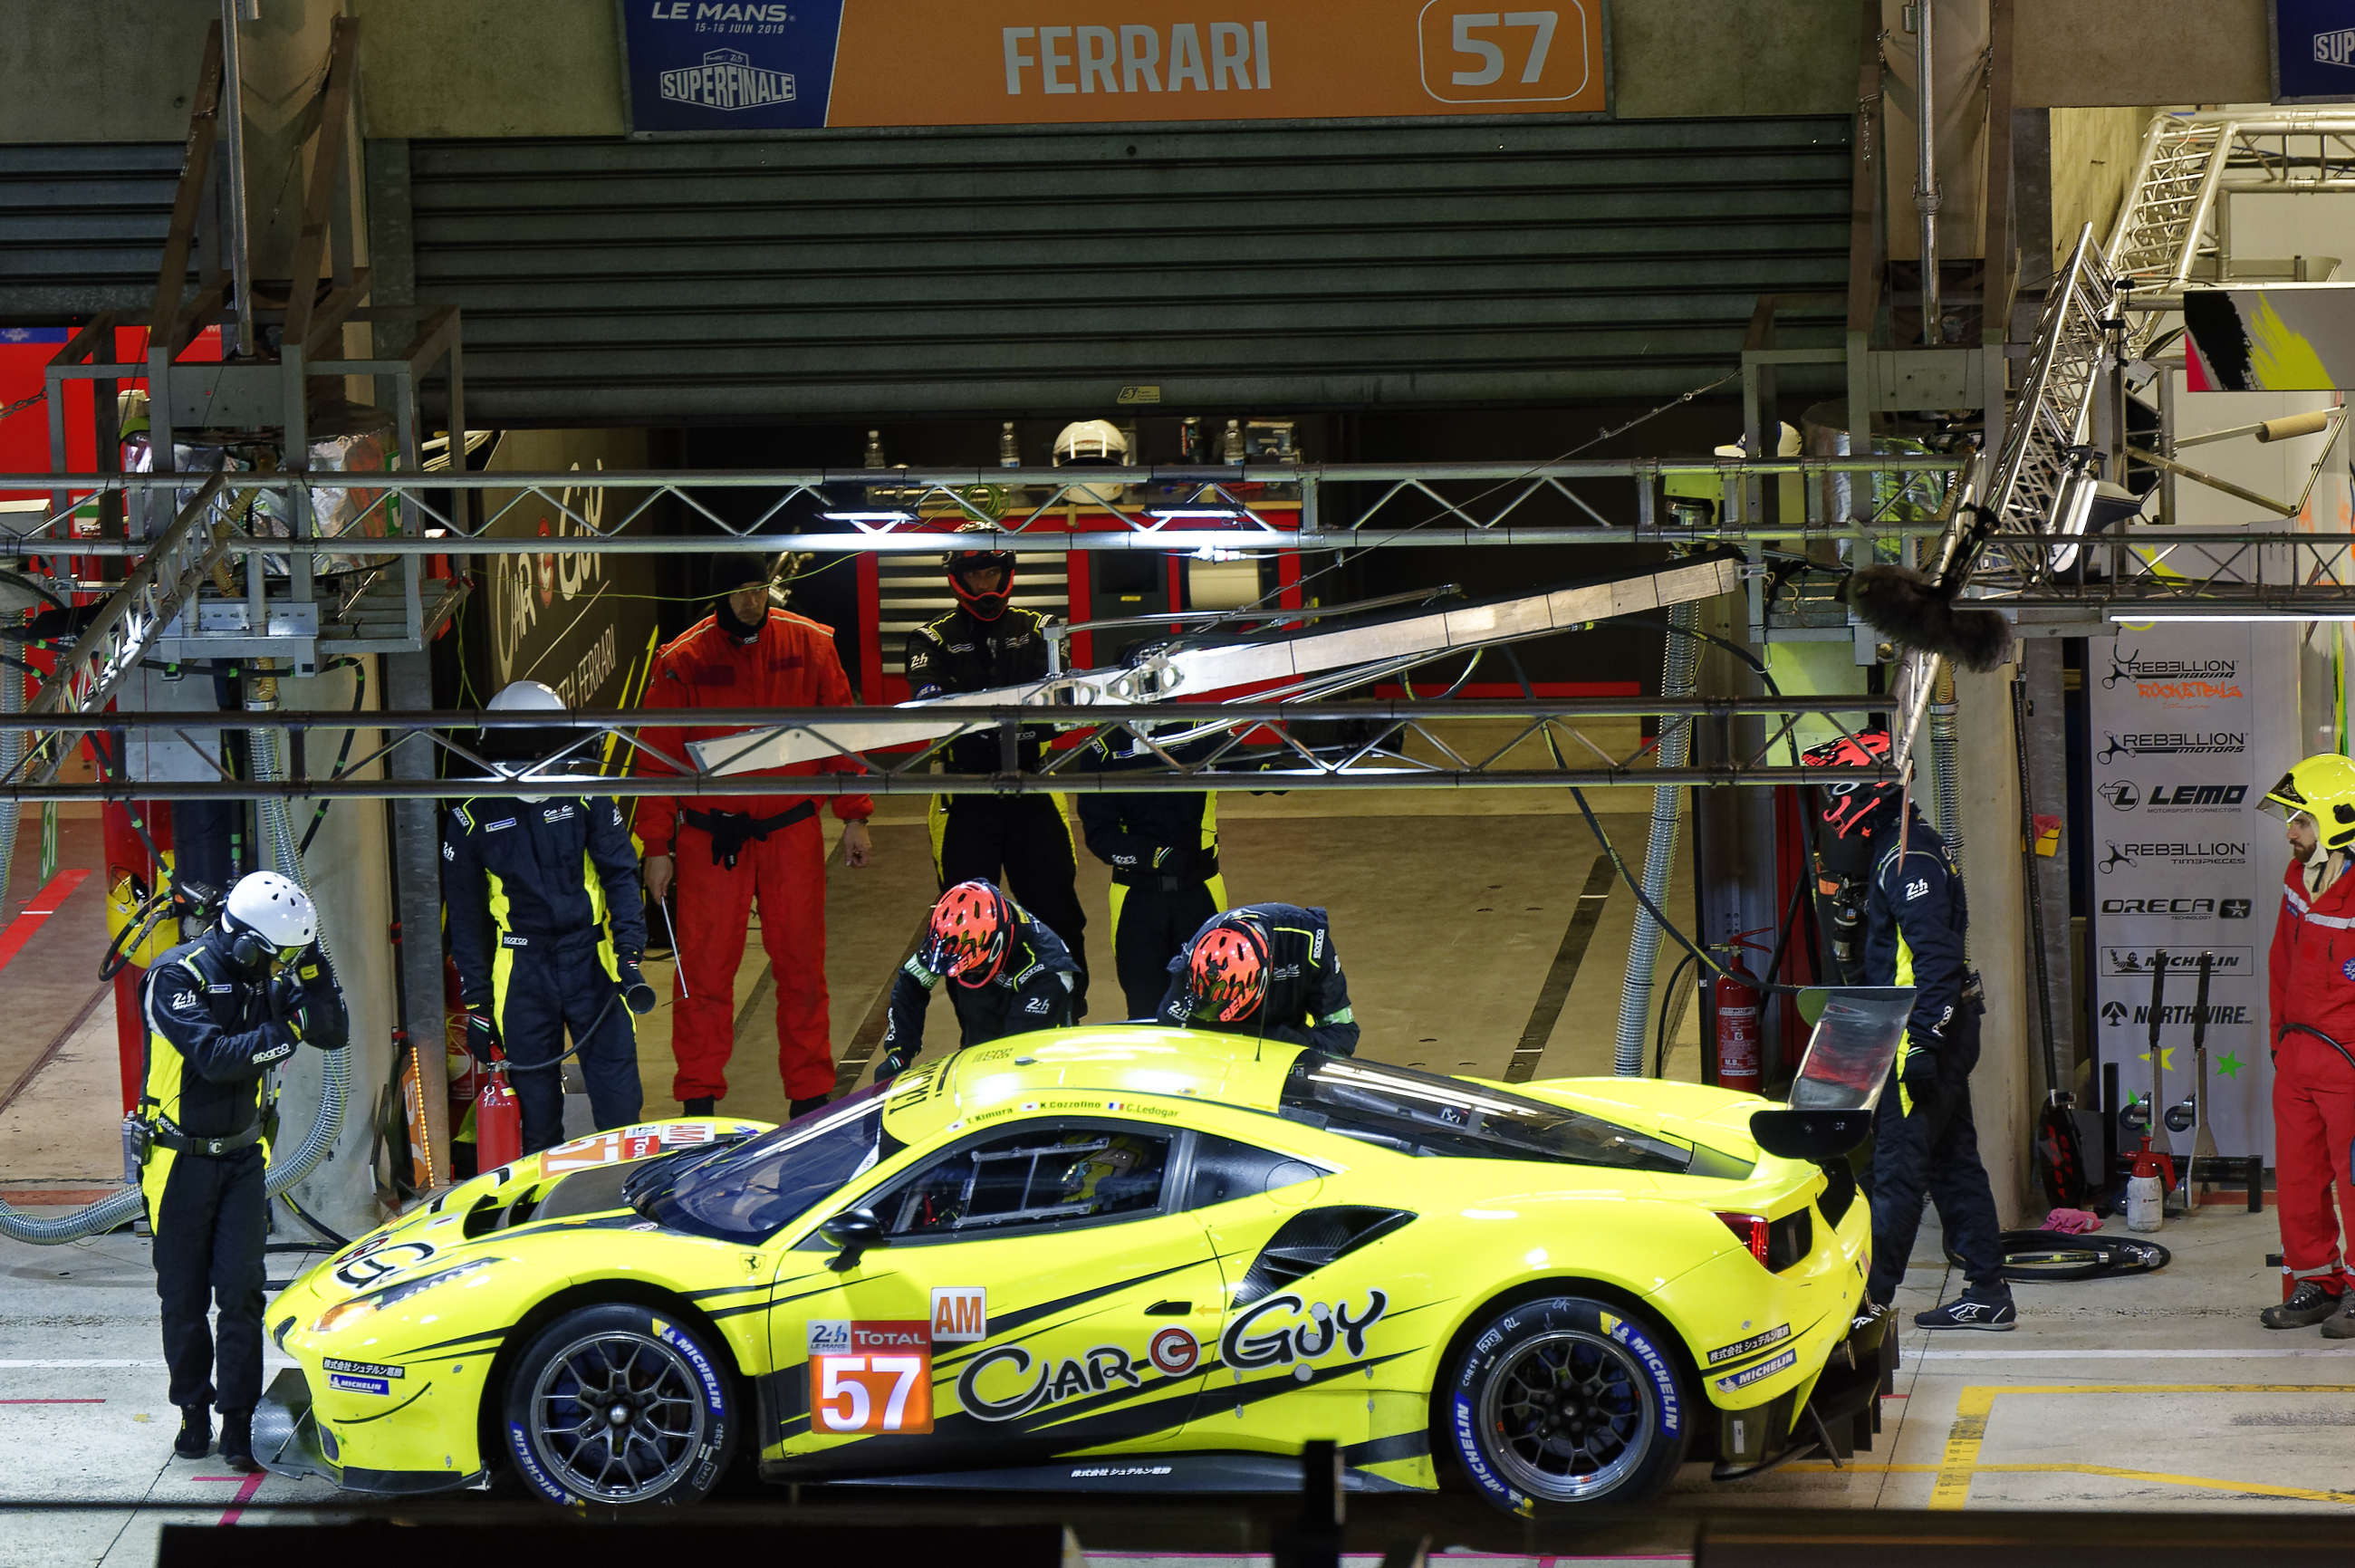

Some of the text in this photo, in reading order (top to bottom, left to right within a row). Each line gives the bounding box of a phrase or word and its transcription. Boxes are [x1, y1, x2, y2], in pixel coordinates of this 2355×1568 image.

[651, 2, 787, 22] LE MANS
[695, 23, 784, 34] 15-16 JUIN 2019
[1003, 21, 1271, 95] FERRARI
[1451, 11, 1559, 86] 57
[664, 65, 793, 107] SUPERFINALE
[578, 623, 615, 709] FERRARI
[2123, 733, 2244, 746] REBELLION
[2148, 785, 2249, 804] LEMO
[2125, 843, 2245, 855] REBELLION
[2101, 899, 2216, 913] ORECA
[547, 1132, 620, 1172] 57
[812, 1324, 848, 1343] 24h
[934, 1296, 982, 1334] AM
[1710, 1344, 1744, 1362] 株式会社
[1739, 1352, 1793, 1384] MICHELIN
[341, 1380, 381, 1390] MICHELIN
[677, 1337, 722, 1409] MICHELIN
[1631, 1336, 1677, 1429] MICHELIN
[821, 1356, 921, 1431] 57
[514, 1429, 562, 1499] MICHELIN
[1457, 1403, 1504, 1494] MICHELIN
